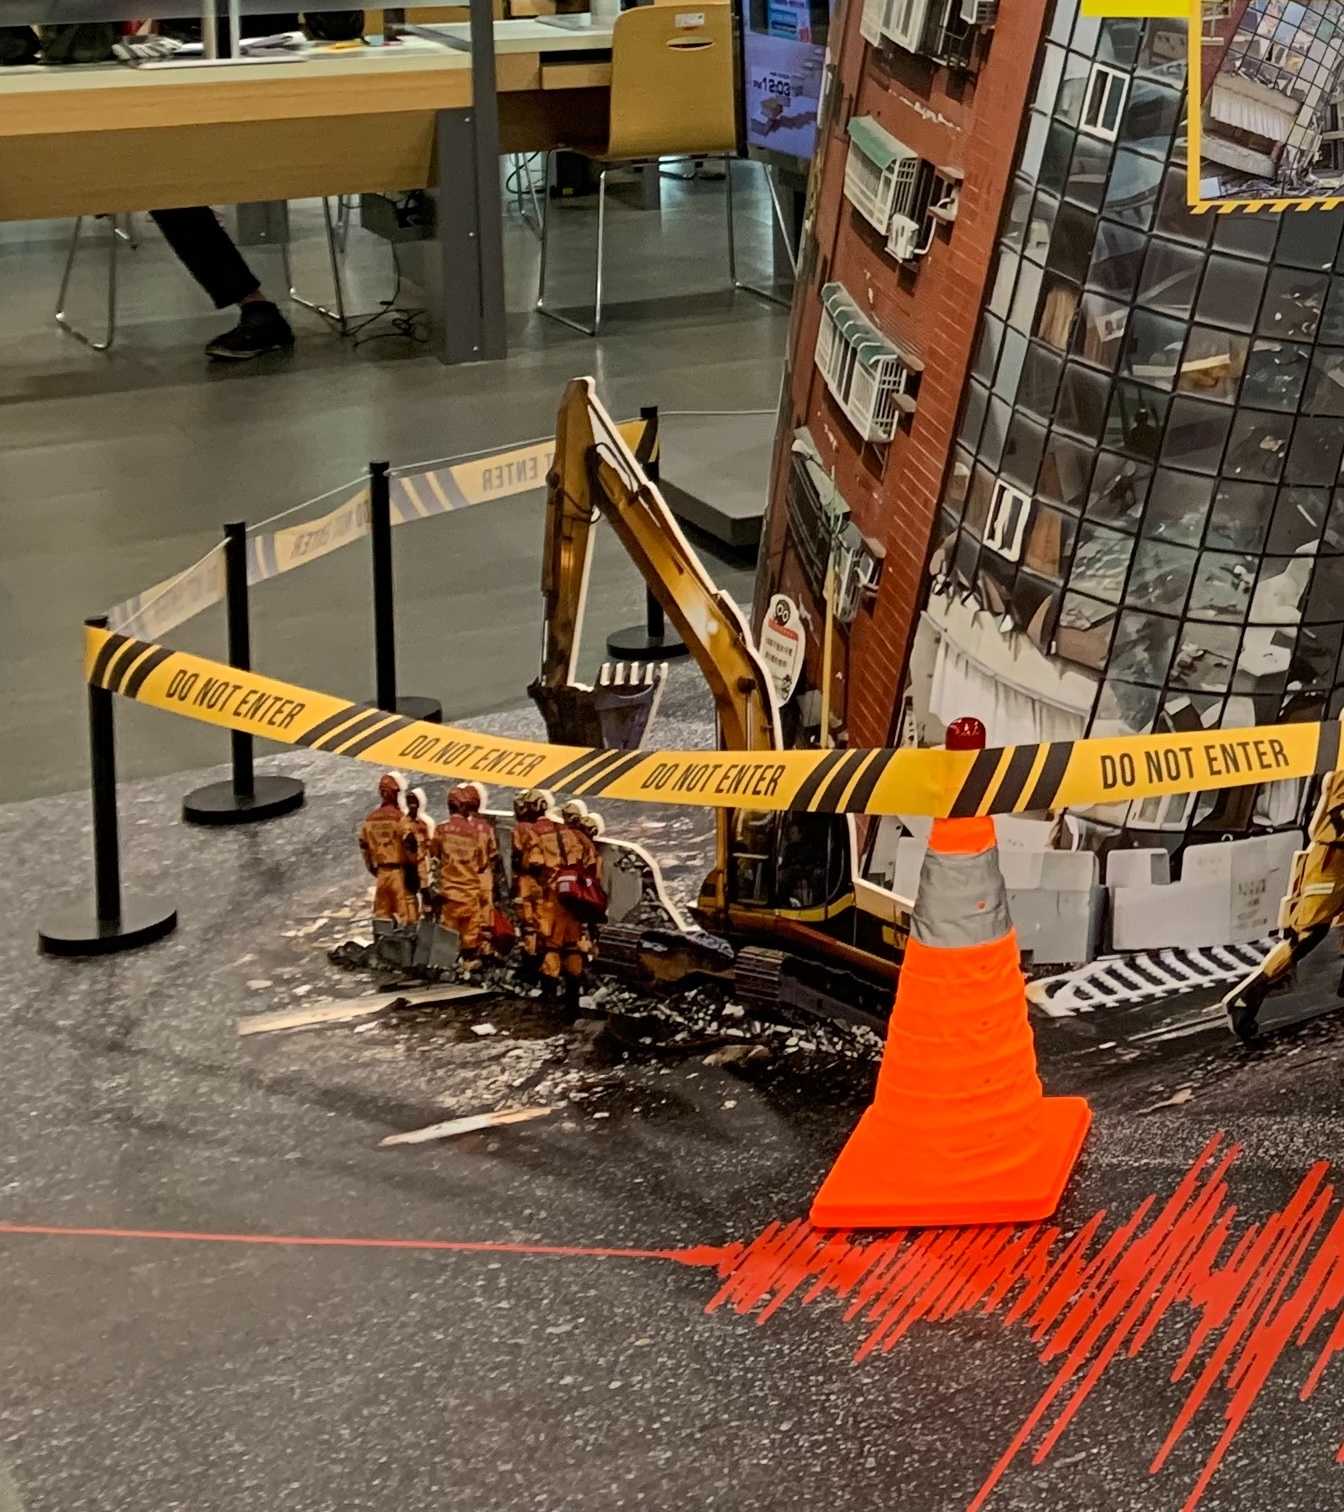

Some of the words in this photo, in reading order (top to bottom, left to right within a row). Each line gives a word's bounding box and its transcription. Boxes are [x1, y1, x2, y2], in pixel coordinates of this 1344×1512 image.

[166, 669, 199, 701] DO
[194, 678, 242, 711] NOT
[233, 690, 305, 729] ENTER
[399, 735, 440, 759] DO
[430, 742, 483, 766] NOT
[470, 749, 546, 777] ENTER
[1100, 753, 1135, 789] DO
[1144, 747, 1193, 783] NOT
[1204, 739, 1289, 775] ENTER
[641, 763, 679, 790] DO
[672, 764, 723, 792] NOT
[714, 764, 786, 796] ENTER
